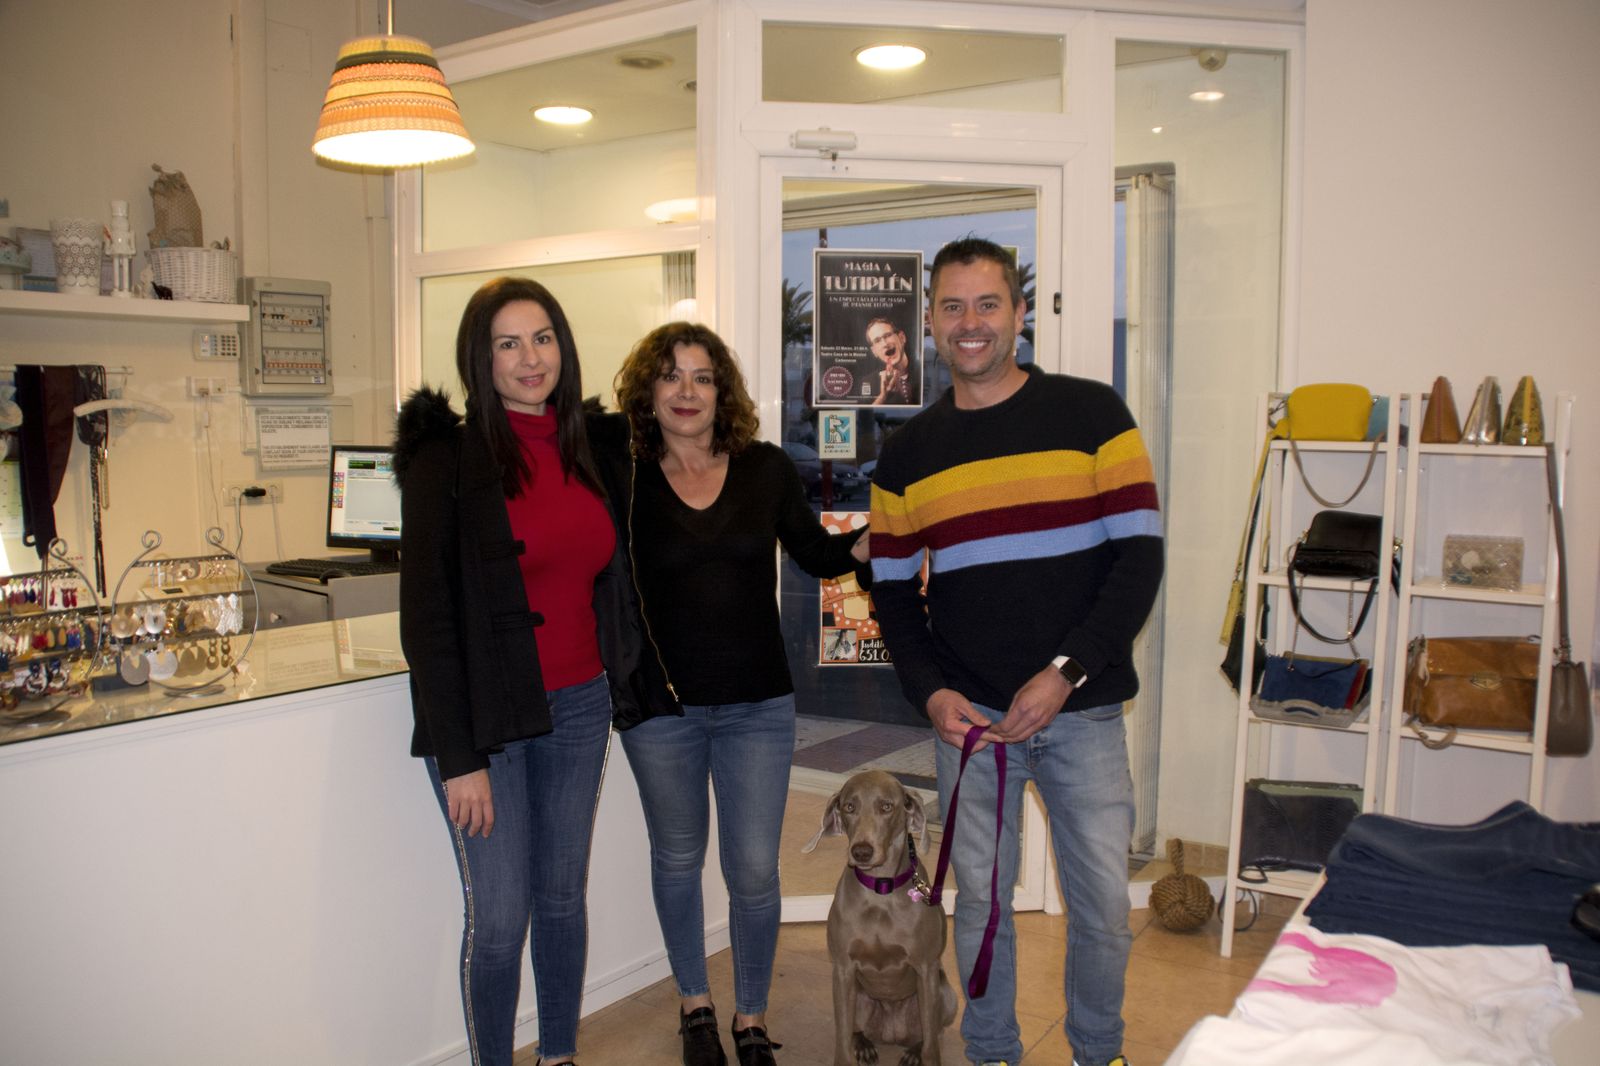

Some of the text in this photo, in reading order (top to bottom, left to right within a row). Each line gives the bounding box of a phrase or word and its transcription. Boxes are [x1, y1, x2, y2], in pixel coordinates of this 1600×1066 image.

[844, 262, 892, 272] MAGIA A
[824, 273, 913, 292] TUTIPLÉN
[859, 649, 880, 662] 651
